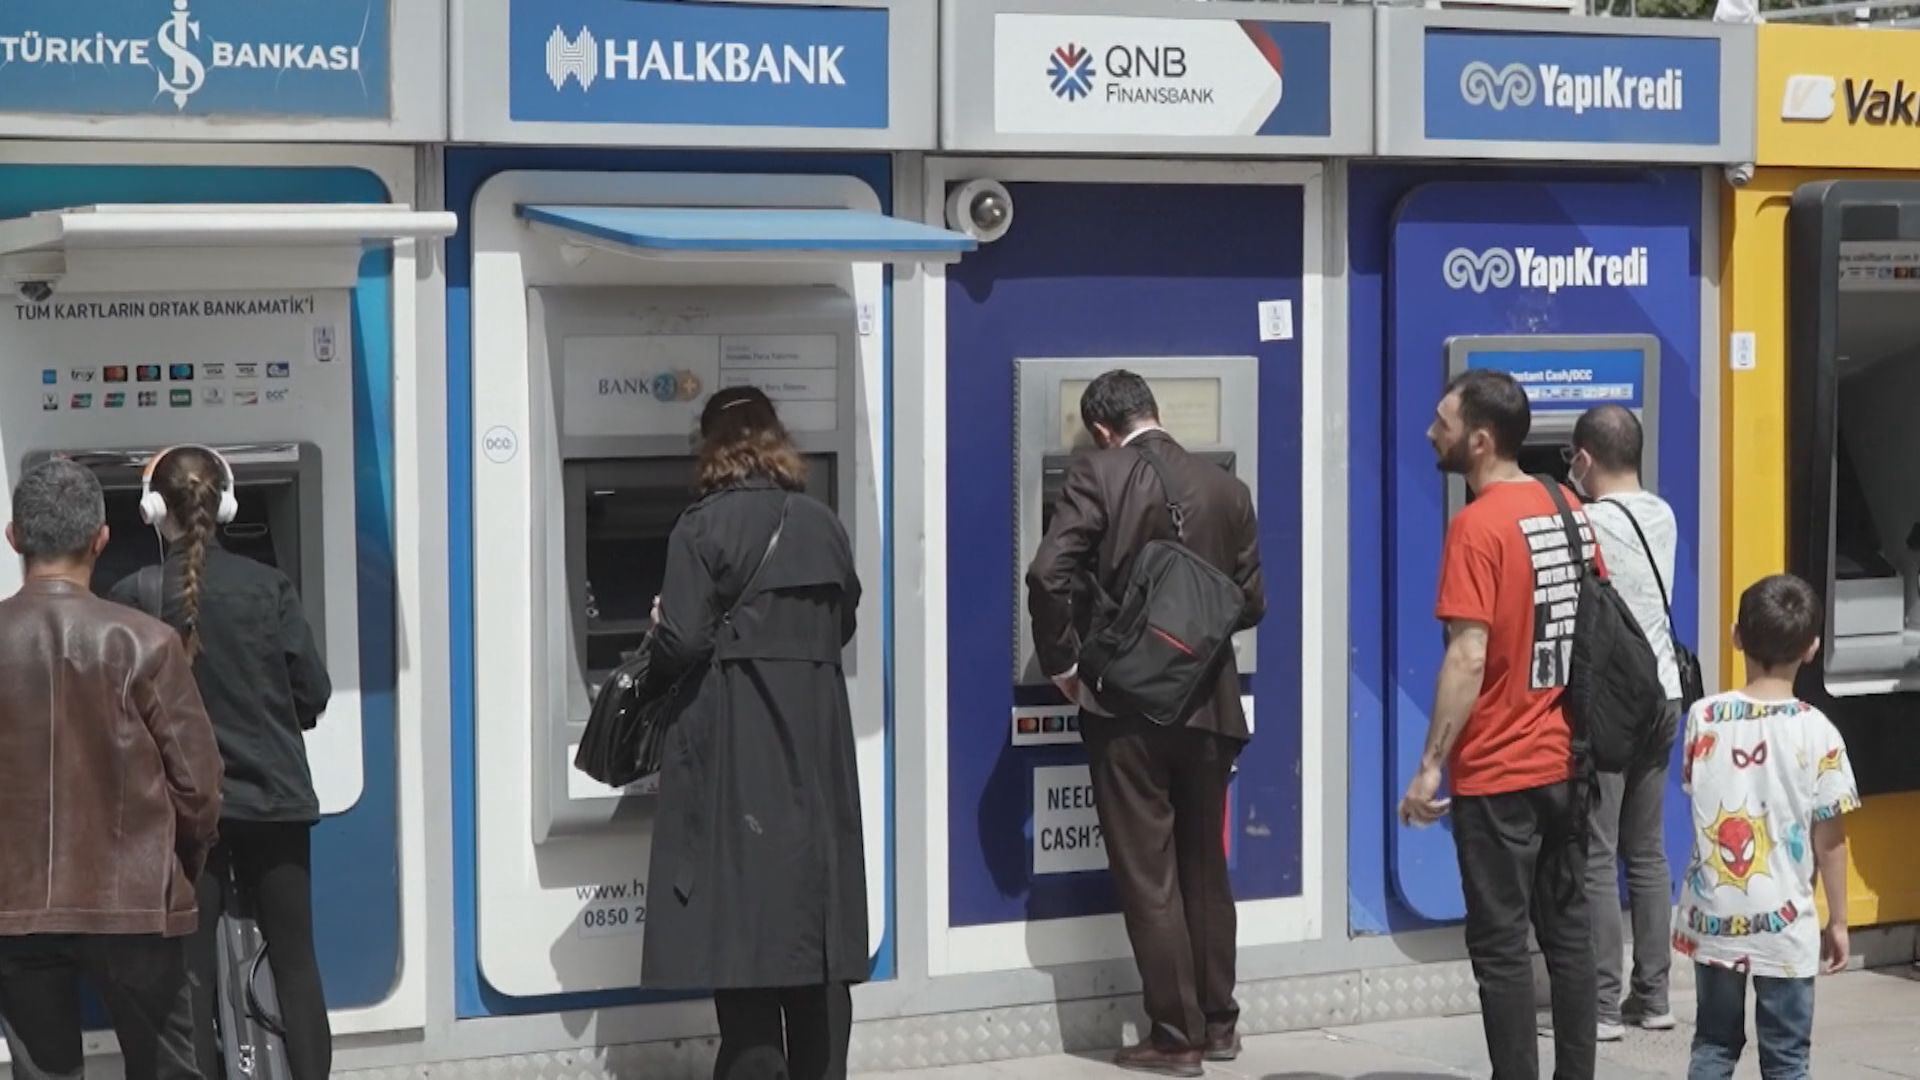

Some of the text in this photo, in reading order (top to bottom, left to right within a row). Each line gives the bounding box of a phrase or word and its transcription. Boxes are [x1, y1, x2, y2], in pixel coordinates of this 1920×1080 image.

[0, 31, 149, 65] TÜRKİYE
[212, 42, 360, 70] BANKASI
[605, 39, 847, 86] HALKBANK
[1105, 46, 1187, 79] QNB
[1538, 64, 1683, 115] YapıKredi
[1515, 247, 1649, 294] YapıKredi
[55, 302, 145, 319] KARTLARIN
[150, 300, 200, 317] ORTAK
[599, 379, 649, 395] BANK
[1047, 785, 1096, 810] NEED
[1040, 825, 1103, 851] CASH?
[584, 907, 629, 928] 0850
